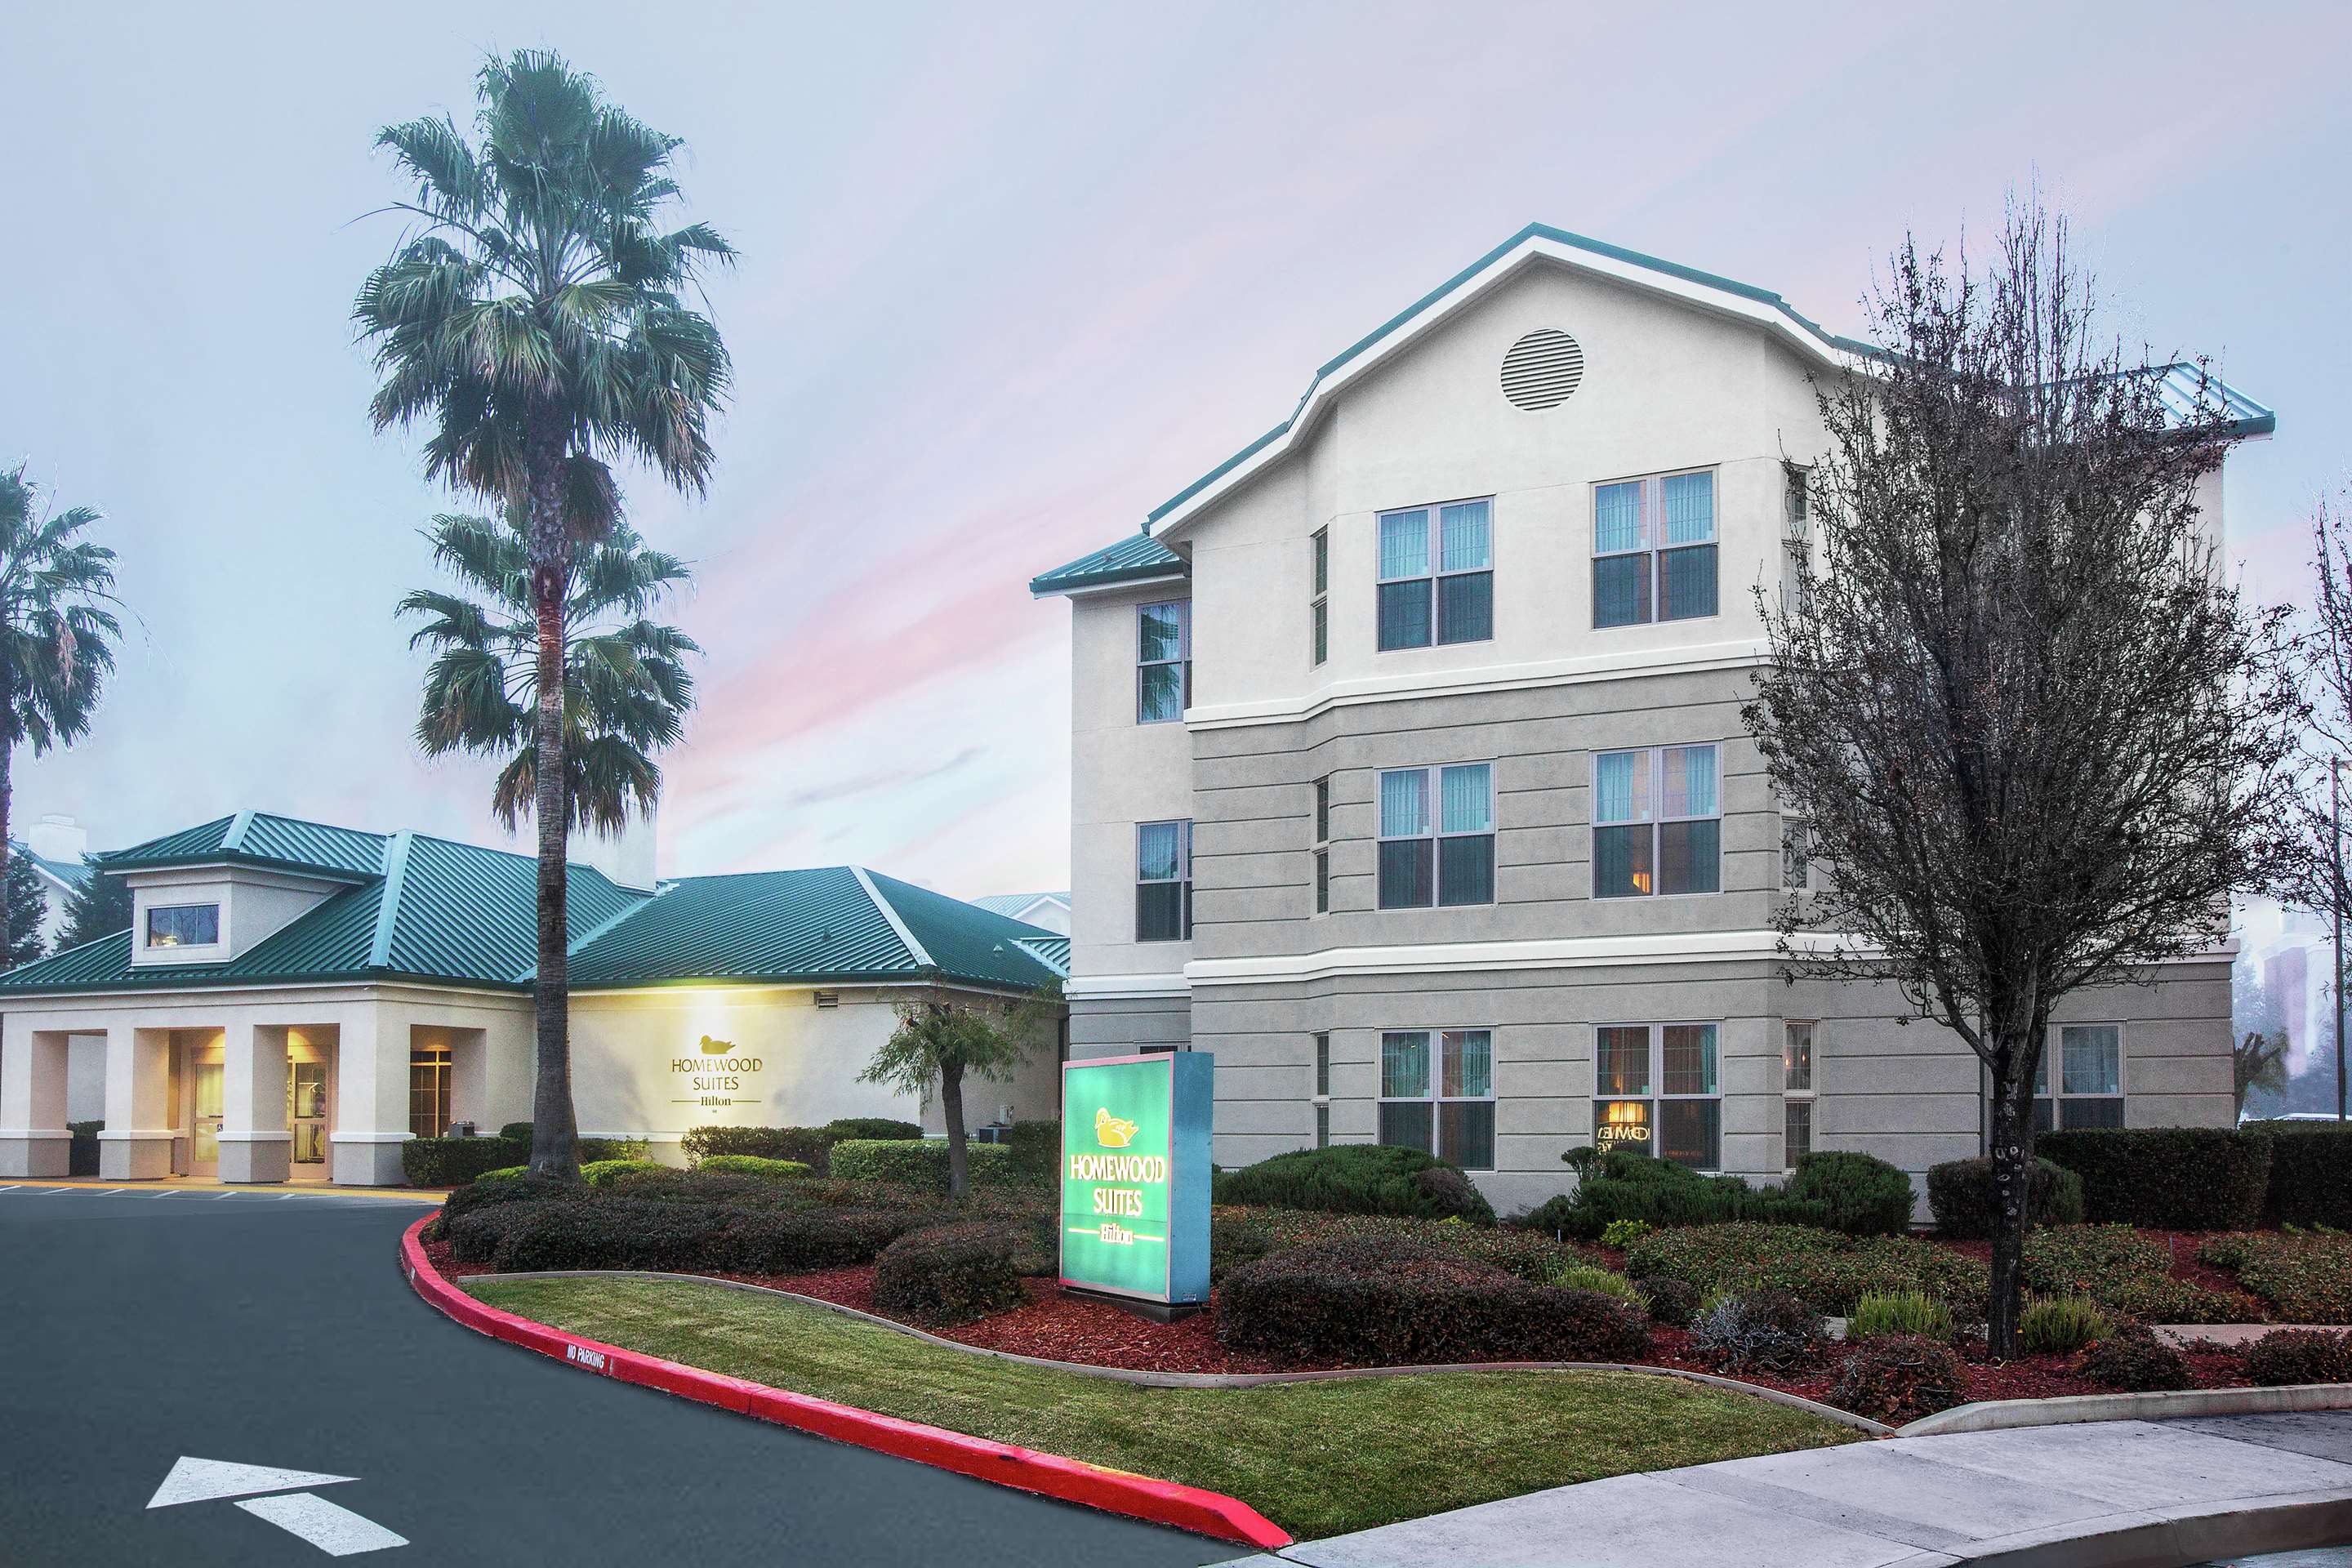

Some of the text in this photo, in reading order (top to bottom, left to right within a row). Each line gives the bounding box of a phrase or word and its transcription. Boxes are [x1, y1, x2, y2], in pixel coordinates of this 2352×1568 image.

[672, 1058, 763, 1072] HOMEWOOD
[693, 1076, 738, 1090] SUITES
[701, 1095, 732, 1106] Hilton
[1070, 1155, 1165, 1183] HOMEWOOD
[1094, 1187, 1143, 1216] SUITES
[1100, 1223, 1134, 1245] Hilton
[567, 1344, 605, 1370] NO PARKING
